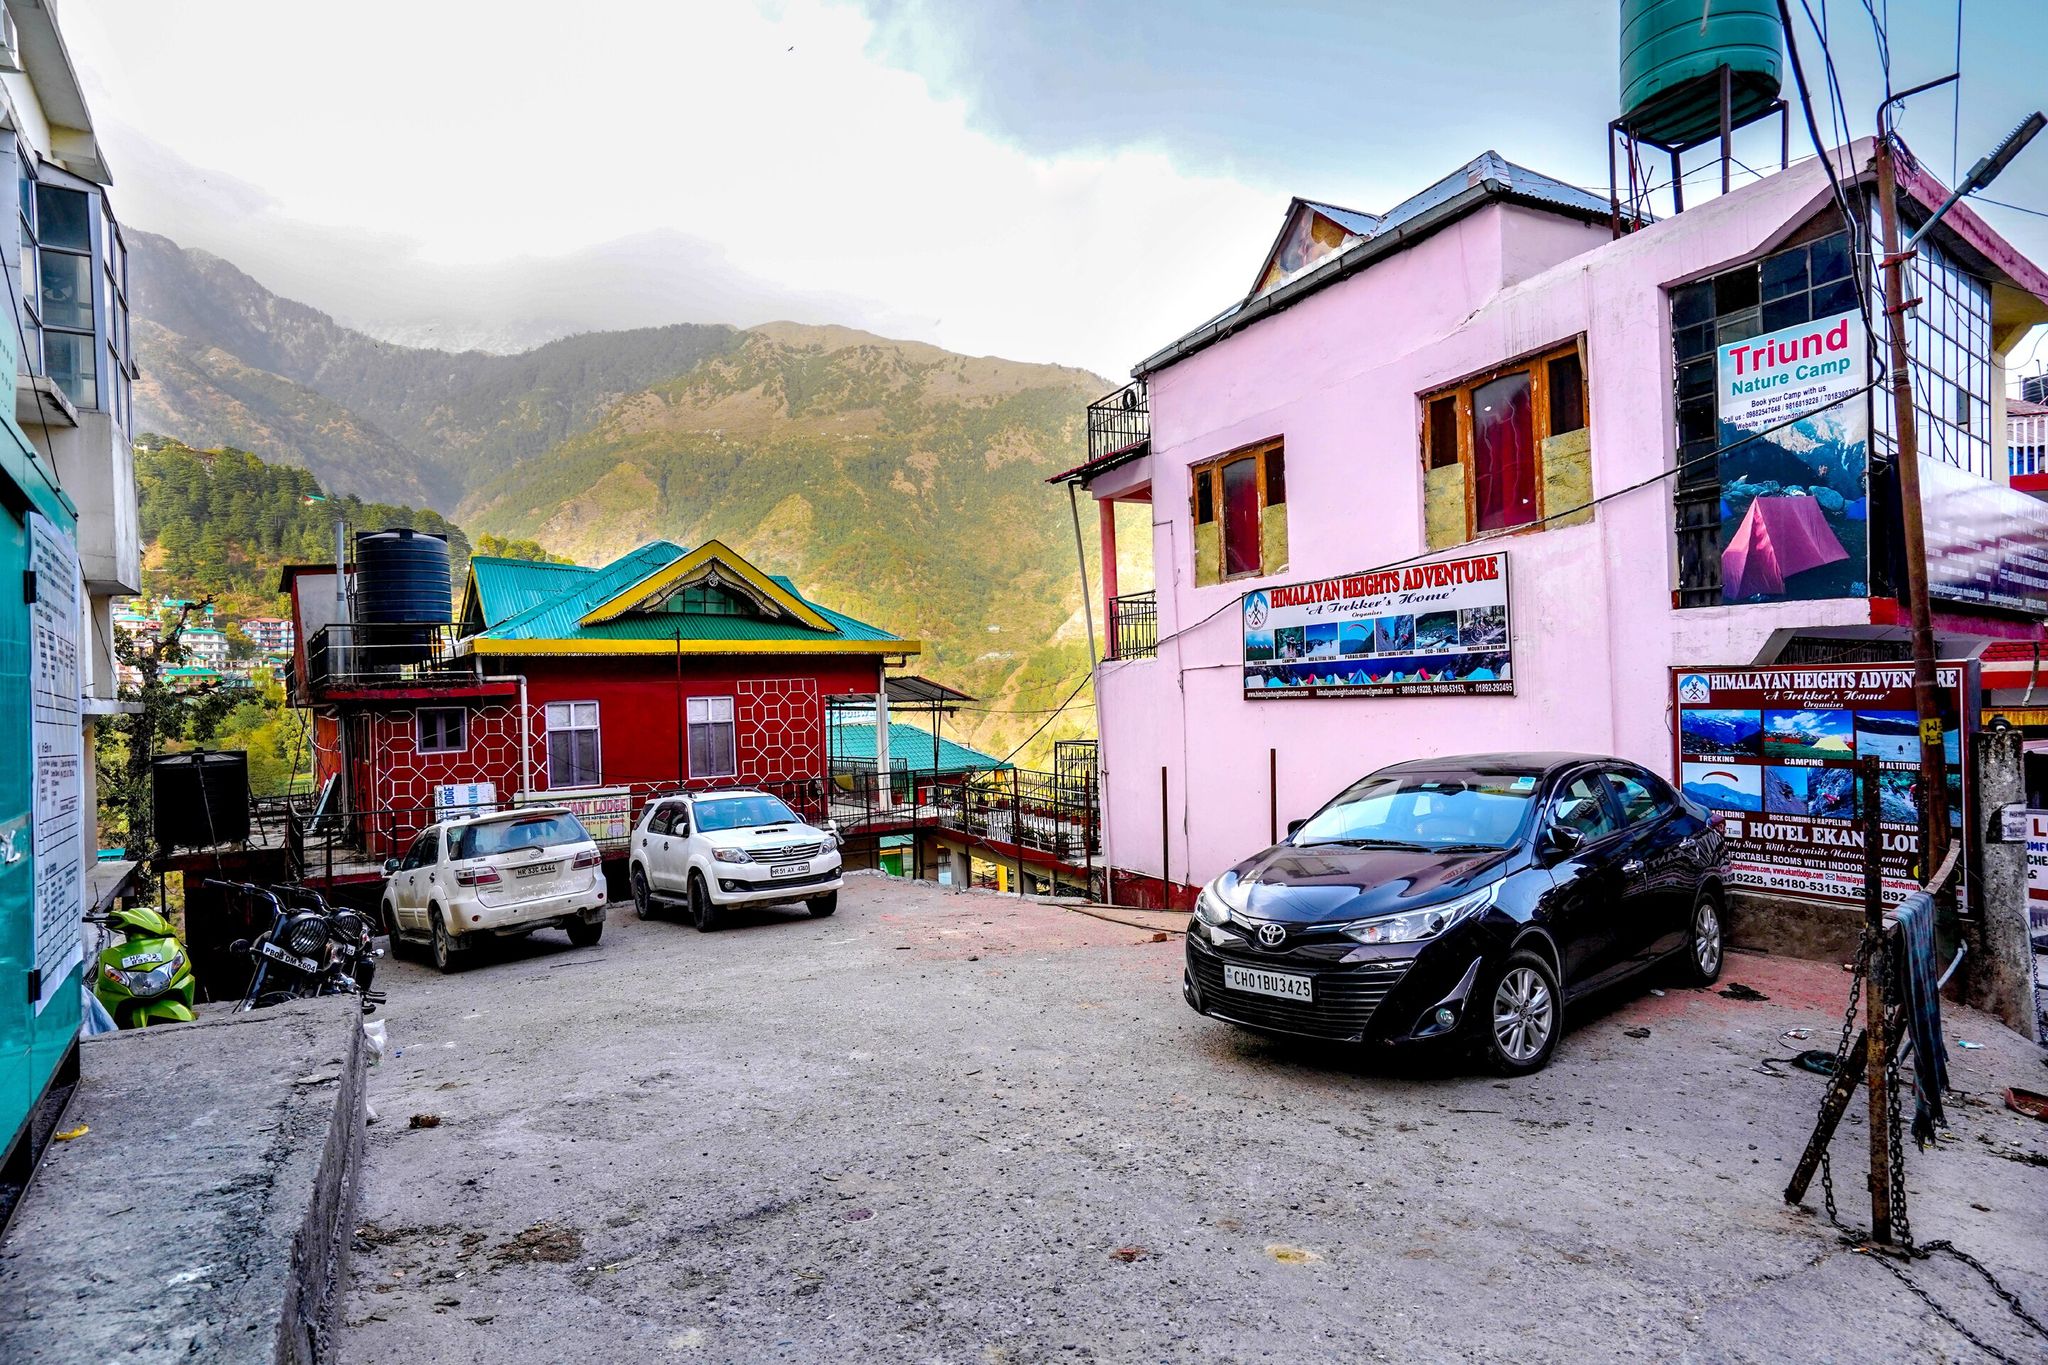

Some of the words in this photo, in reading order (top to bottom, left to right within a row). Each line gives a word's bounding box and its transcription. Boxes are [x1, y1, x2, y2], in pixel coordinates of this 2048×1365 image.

[1730, 319, 1848, 375] Triund
[1732, 373, 1789, 396] Nature
[1795, 358, 1851, 380] Camp
[1752, 399, 1767, 407] Book
[1768, 396, 1782, 405] your
[1784, 391, 1801, 400] Camp
[1803, 387, 1816, 395] with
[1723, 415, 1733, 423] Call
[1737, 421, 1758, 429] Website
[1271, 580, 1340, 608] HIMALAYAN
[1342, 571, 1400, 599] HEIGHTS
[1403, 556, 1498, 590] ADVENTURE
[1327, 597, 1391, 612] Trekker's
[1352, 610, 1382, 618] Organises
[1710, 674, 1790, 690] HIMALAYAN
[1793, 672, 1856, 689] HEIGHTS
[1860, 670, 1957, 688] ADVENRE
[1783, 690, 1838, 701] Trekker's
[1784, 758, 1824, 766] CAMPING
[1886, 762, 1921, 770] ALTITUDE
[444, 786, 454, 806] ODGE
[594, 799, 626, 814] LODGE
[1785, 815, 1811, 823] CLIMBING
[1817, 818, 1852, 826] RAPPELLING
[2033, 818, 2048, 837] L
[1750, 822, 1808, 842] HOTEL
[1812, 827, 1865, 848] EKAN
[1728, 851, 1771, 862] FORTABLE
[1773, 855, 1802, 865] ROOMS
[1804, 859, 1826, 869] WITH
[1828, 861, 1863, 872] INDOOR
[1743, 840, 1761, 850] Stay
[1765, 842, 1785, 852] With
[1788, 844, 1828, 855] Exquisite
[1831, 848, 1865, 860] Natura
[1881, 856, 1908, 865] eauty
[1773, 868, 1824, 880] www.ekantlodge.com
[2028, 869, 2037, 879] &
[1770, 877, 1851, 896] 94180-53153,
[1234, 970, 1310, 996] CH01BU3425
